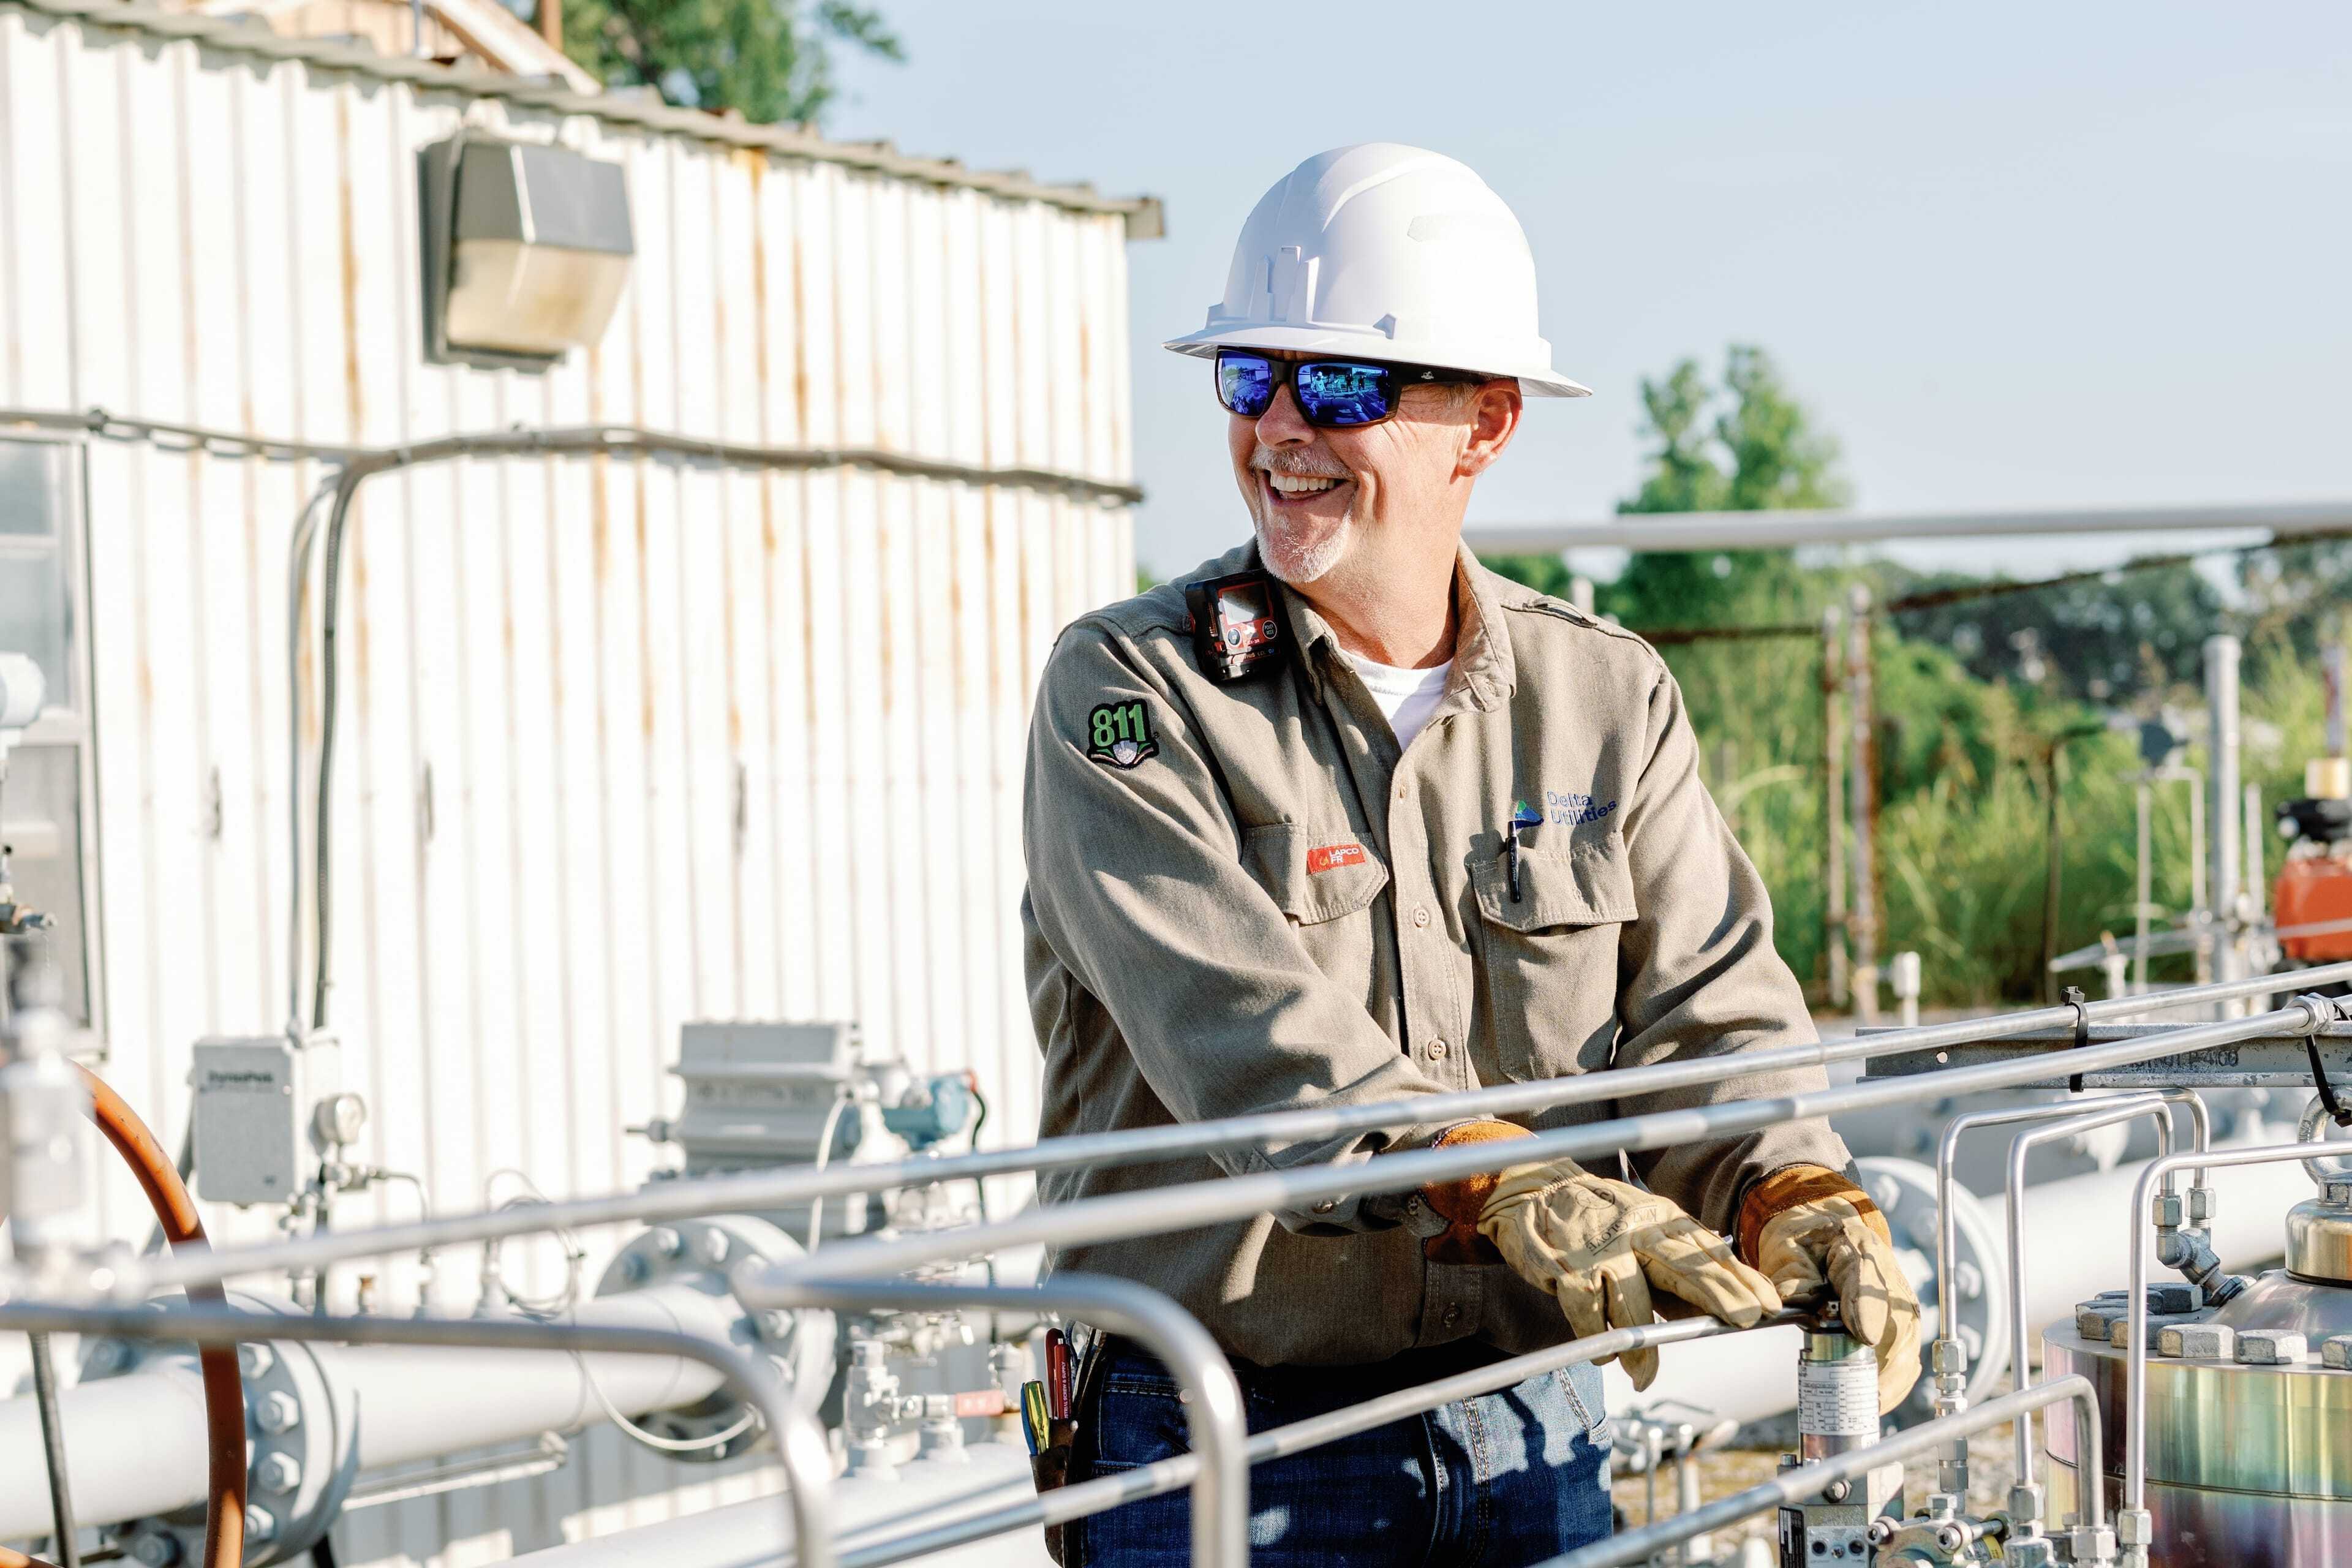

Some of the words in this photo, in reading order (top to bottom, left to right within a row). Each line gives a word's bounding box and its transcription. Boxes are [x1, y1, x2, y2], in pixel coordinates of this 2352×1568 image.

[1093, 704, 1146, 747] 811
[1547, 791, 1593, 807] Delta
[1551, 801, 1617, 826] Utilities
[1329, 848, 1359, 857] LAPCO
[1586, 1220, 1628, 1252] GLOVE
